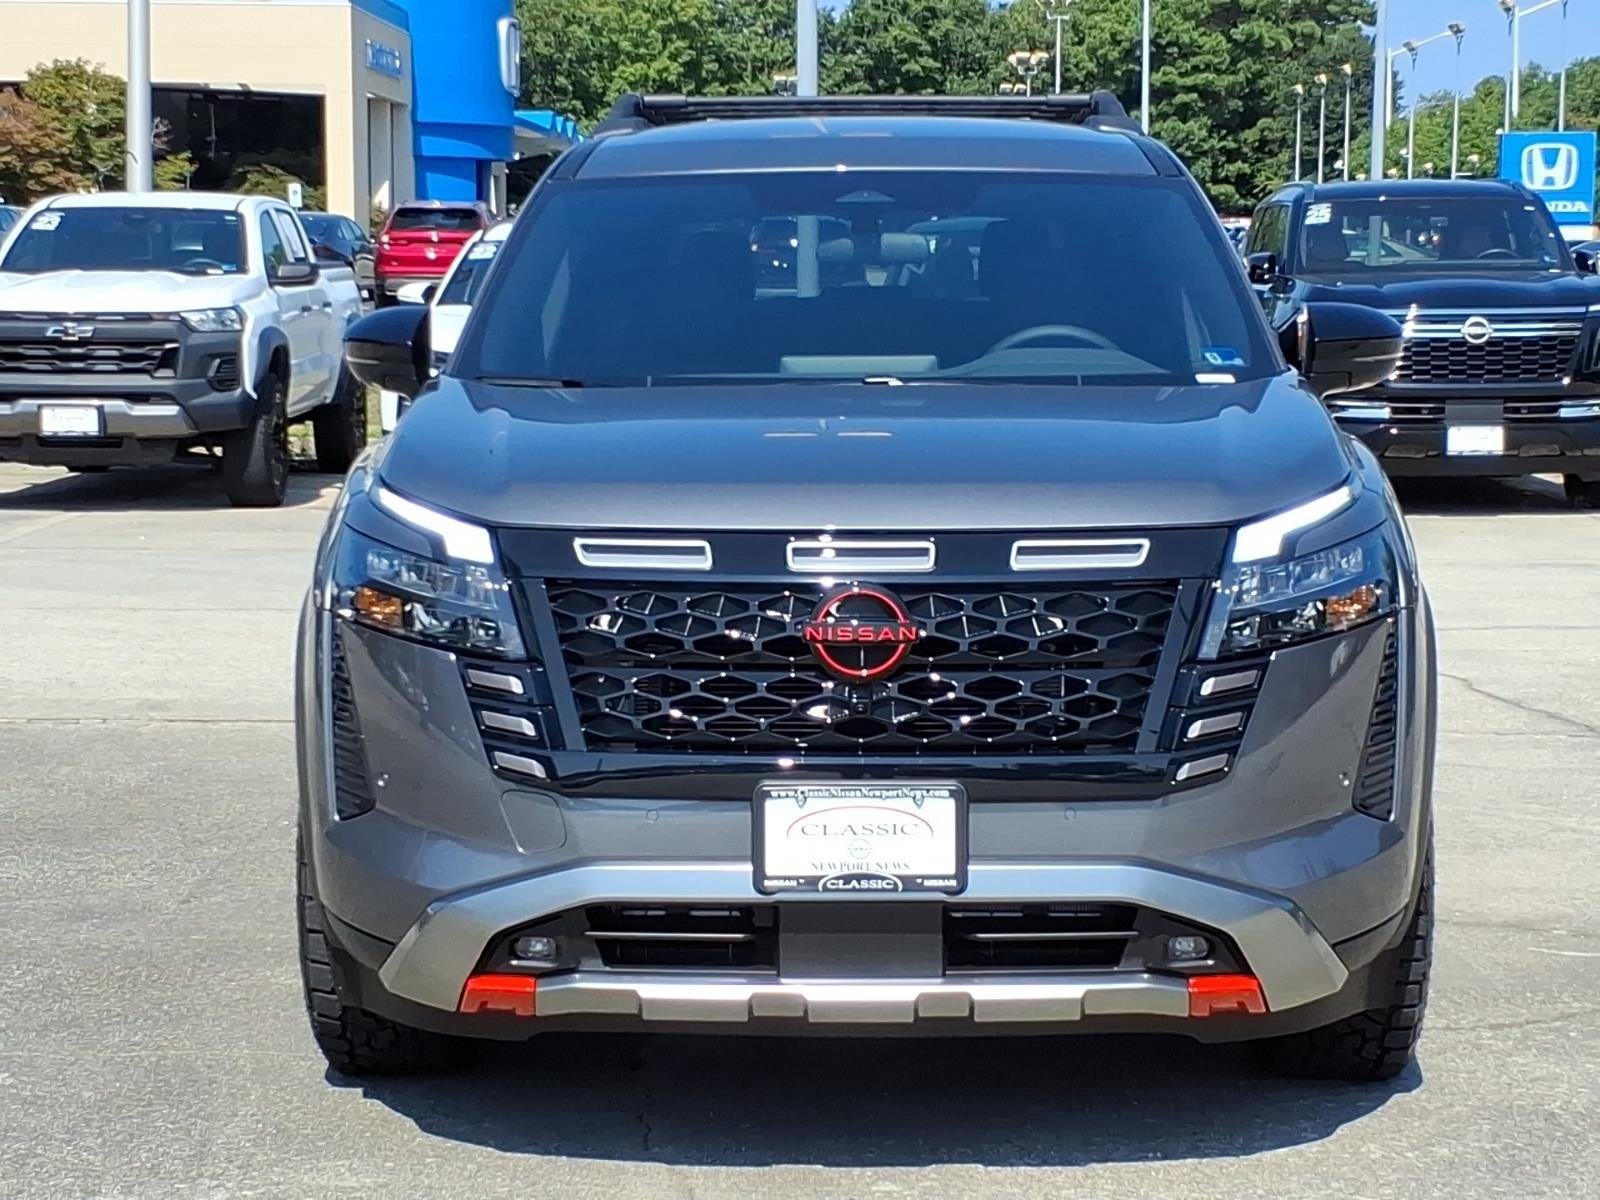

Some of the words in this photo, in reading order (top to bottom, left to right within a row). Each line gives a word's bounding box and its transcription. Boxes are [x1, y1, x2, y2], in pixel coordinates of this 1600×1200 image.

[1545, 200, 1590, 213] NDA
[805, 626, 917, 641] NISSAN
[801, 823, 919, 836] CLASSIC
[811, 861, 870, 872] NEWPORT
[876, 861, 911, 872] NEWS
[826, 879, 894, 890] CLASSIC
